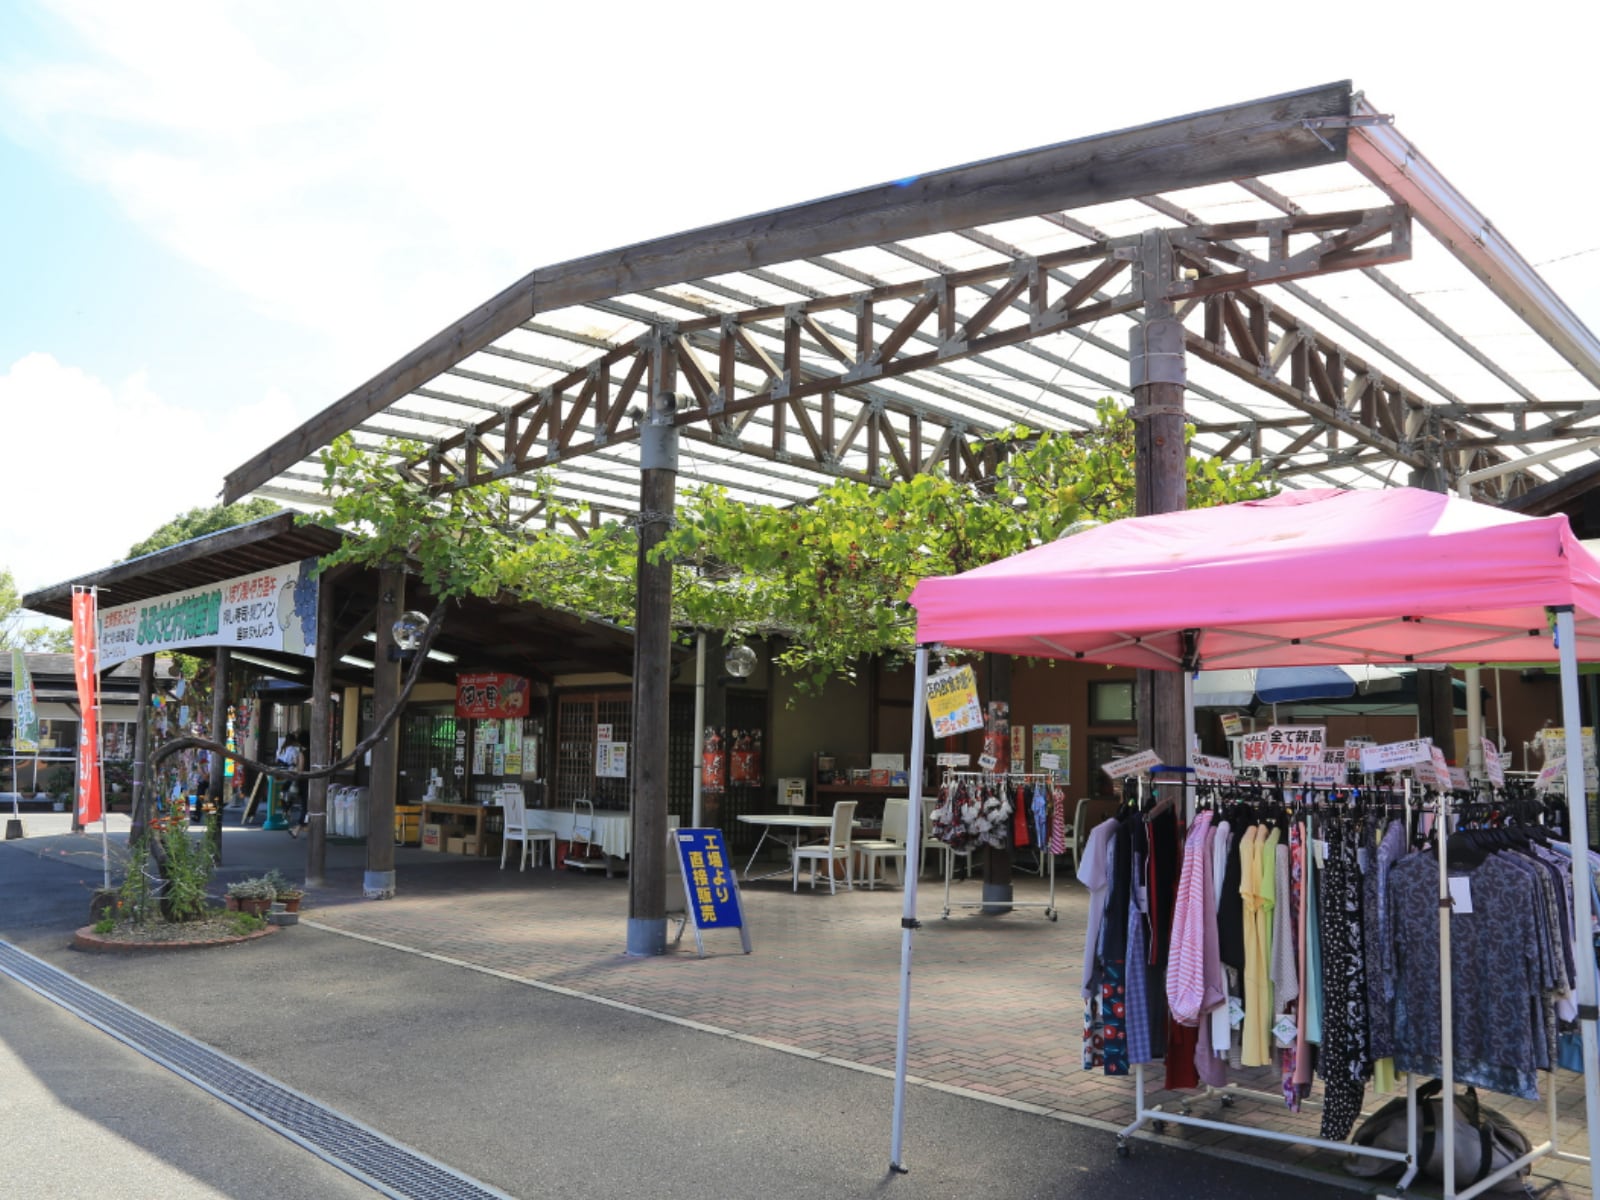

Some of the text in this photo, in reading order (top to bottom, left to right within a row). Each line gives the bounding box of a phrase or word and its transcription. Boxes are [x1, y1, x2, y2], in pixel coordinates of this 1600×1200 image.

[1270, 729, 1322, 743] 全て新品
[1270, 743, 1320, 755] アウトレット
[1303, 764, 1344, 776] アウトレット
[704, 834, 729, 903] 工場より
[688, 851, 717, 922] 直接販売
